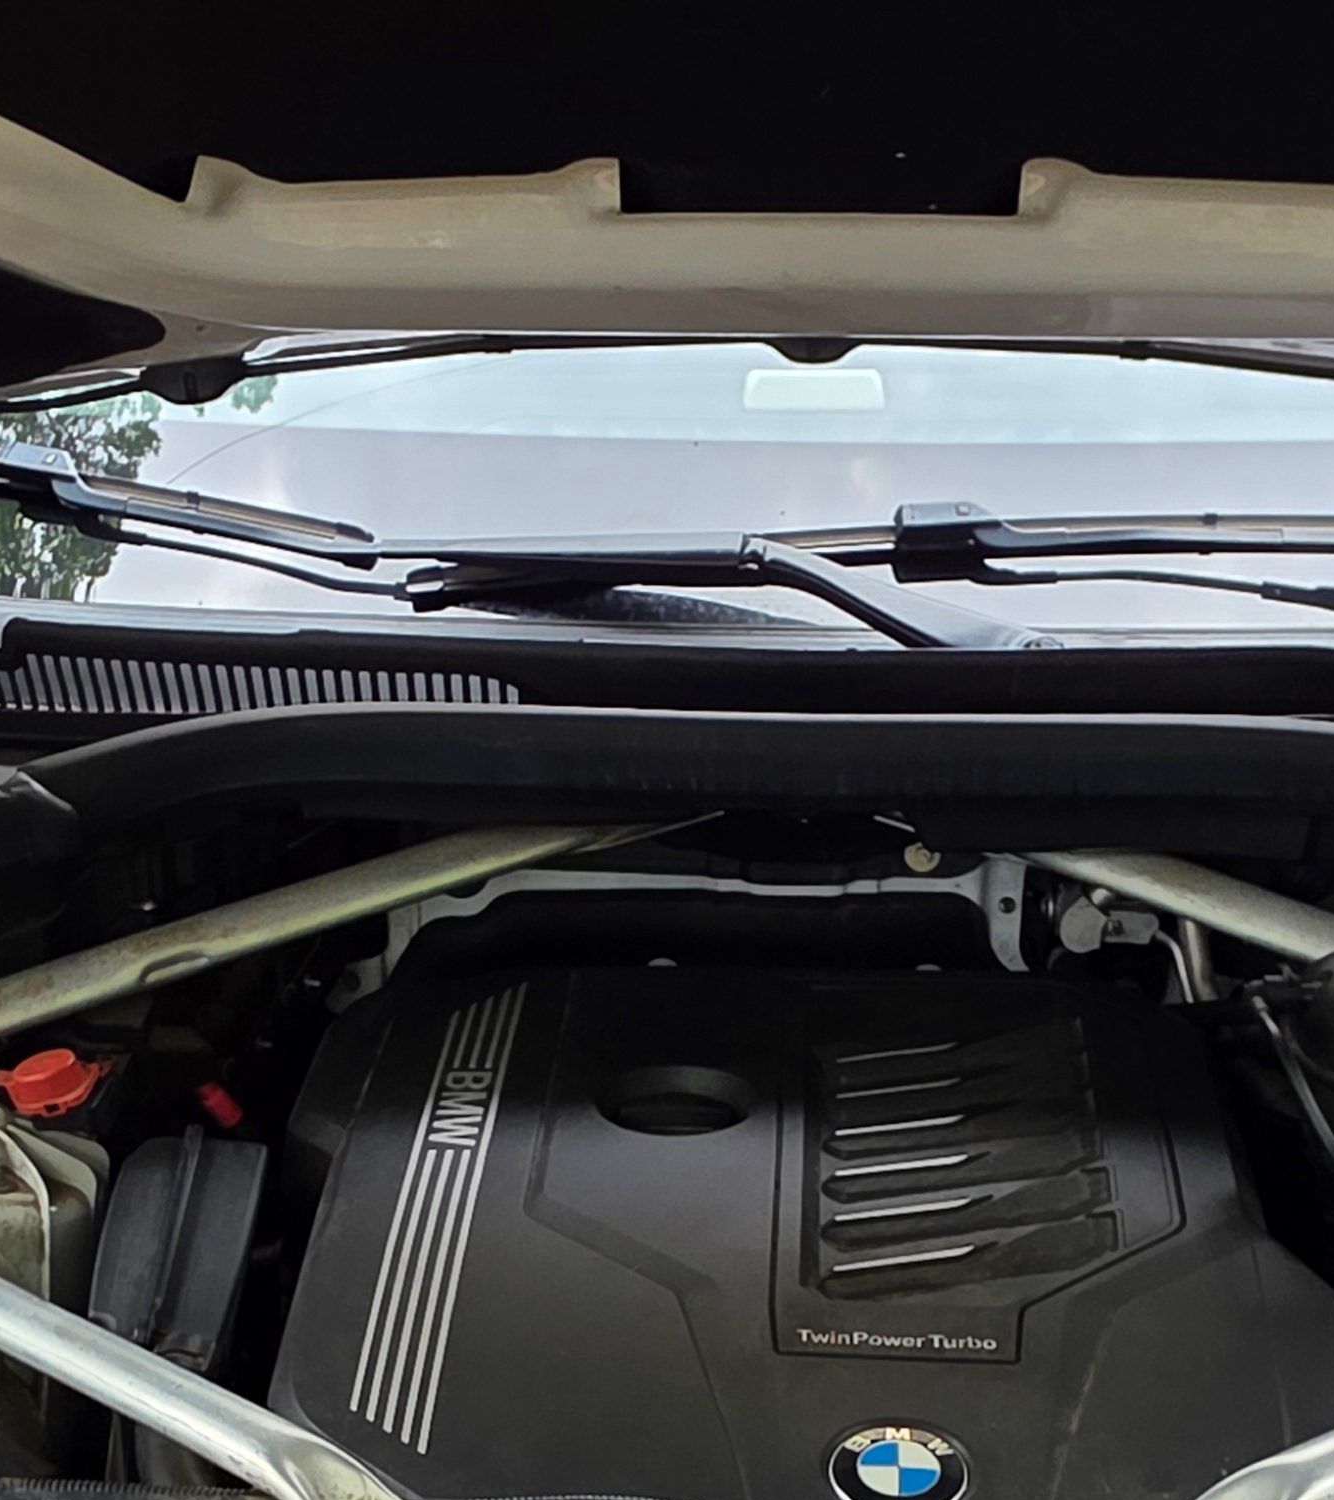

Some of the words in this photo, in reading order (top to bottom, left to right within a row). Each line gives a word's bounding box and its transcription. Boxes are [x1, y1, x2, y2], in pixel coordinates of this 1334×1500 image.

[428, 1071, 493, 1146] BMW
[796, 1328, 925, 1348] TwinPower
[927, 1333, 998, 1350] Turbo
[843, 1427, 955, 1456] BMW
